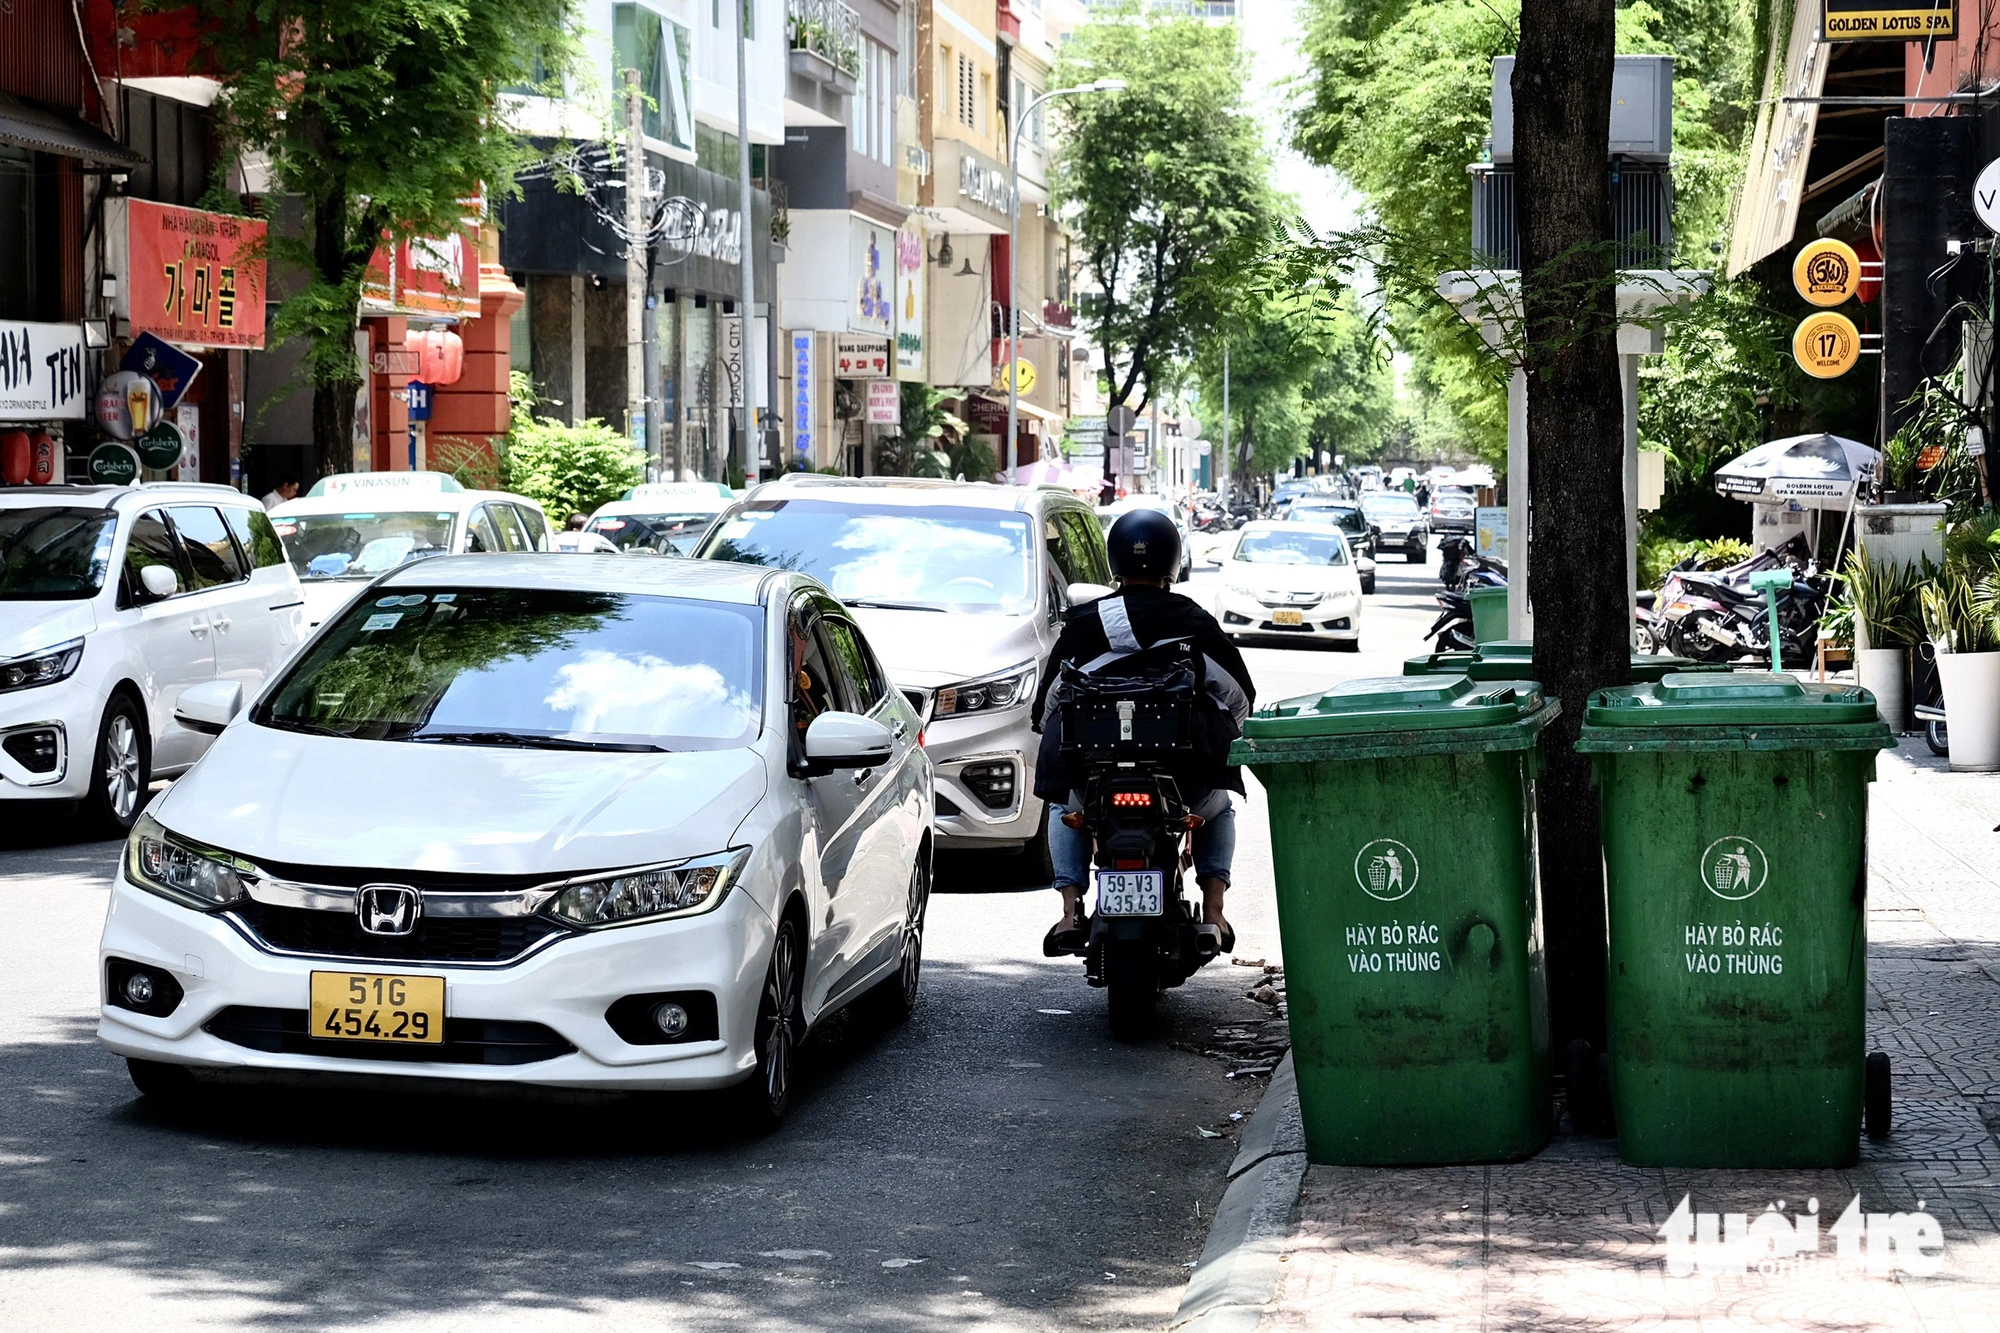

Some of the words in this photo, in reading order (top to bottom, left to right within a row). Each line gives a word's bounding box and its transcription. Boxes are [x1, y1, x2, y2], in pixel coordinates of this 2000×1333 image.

[1828, 17, 1878, 32] GOLDEN
[1882, 16, 1922, 30] LOTUS
[1926, 15, 1950, 30] SPA
[729, 322, 741, 348] CITY
[1818, 334, 1836, 357] 17
[838, 344, 855, 353] WANG
[856, 344, 887, 353] DAEPPANG
[1816, 359, 1841, 367] WELCOME
[46, 342, 81, 409] TEN
[794, 337, 810, 431] MASSAGE
[138, 436, 179, 450] Carlsberg
[93, 459, 134, 475] Carlsberg
[353, 477, 410, 488] VINASUN
[1179, 643, 1191, 652] TM
[1108, 875, 1153, 893] 59-V3
[1103, 894, 1157, 913] 435.43
[1345, 922, 1376, 946] HÃY
[1381, 919, 1402, 946] BỎ
[1407, 920, 1439, 945] RÁC
[1685, 922, 1718, 946] HÃY
[1722, 919, 1745, 947] BỎ
[1749, 921, 1783, 947] RÁC
[1347, 948, 1382, 973] VÀO
[1385, 947, 1441, 973] THÙNG
[1685, 948, 1721, 974] VÀO
[1725, 950, 1783, 975] THÙNG
[349, 976, 406, 1006] 51G
[325, 1008, 429, 1039] 454.29
